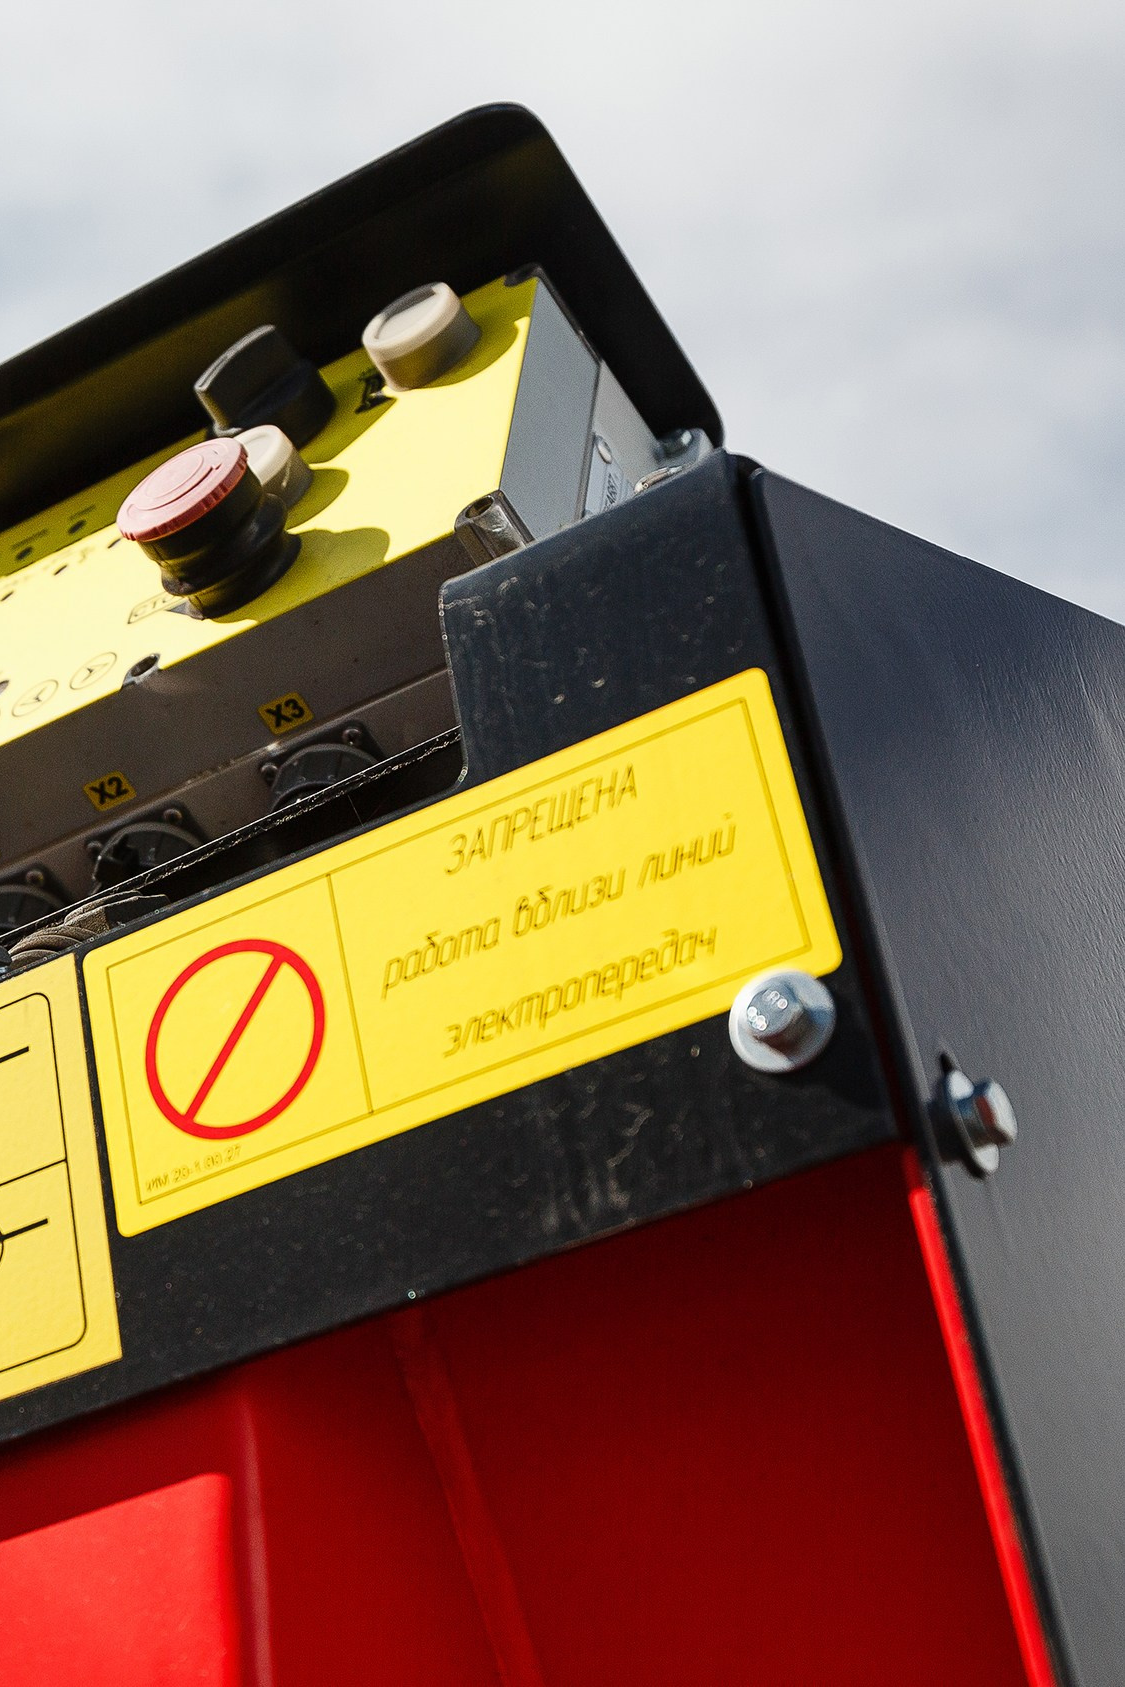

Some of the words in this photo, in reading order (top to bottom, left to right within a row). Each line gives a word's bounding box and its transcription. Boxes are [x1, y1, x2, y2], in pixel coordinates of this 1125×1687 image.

[265, 698, 305, 728] X3
[89, 776, 129, 805] X2
[444, 764, 638, 875] ЗАПРЕЩЕНА
[381, 917, 502, 1000] работа
[512, 867, 626, 938] вблизи
[637, 812, 737, 889] линий
[442, 926, 718, 1058] электропередач
